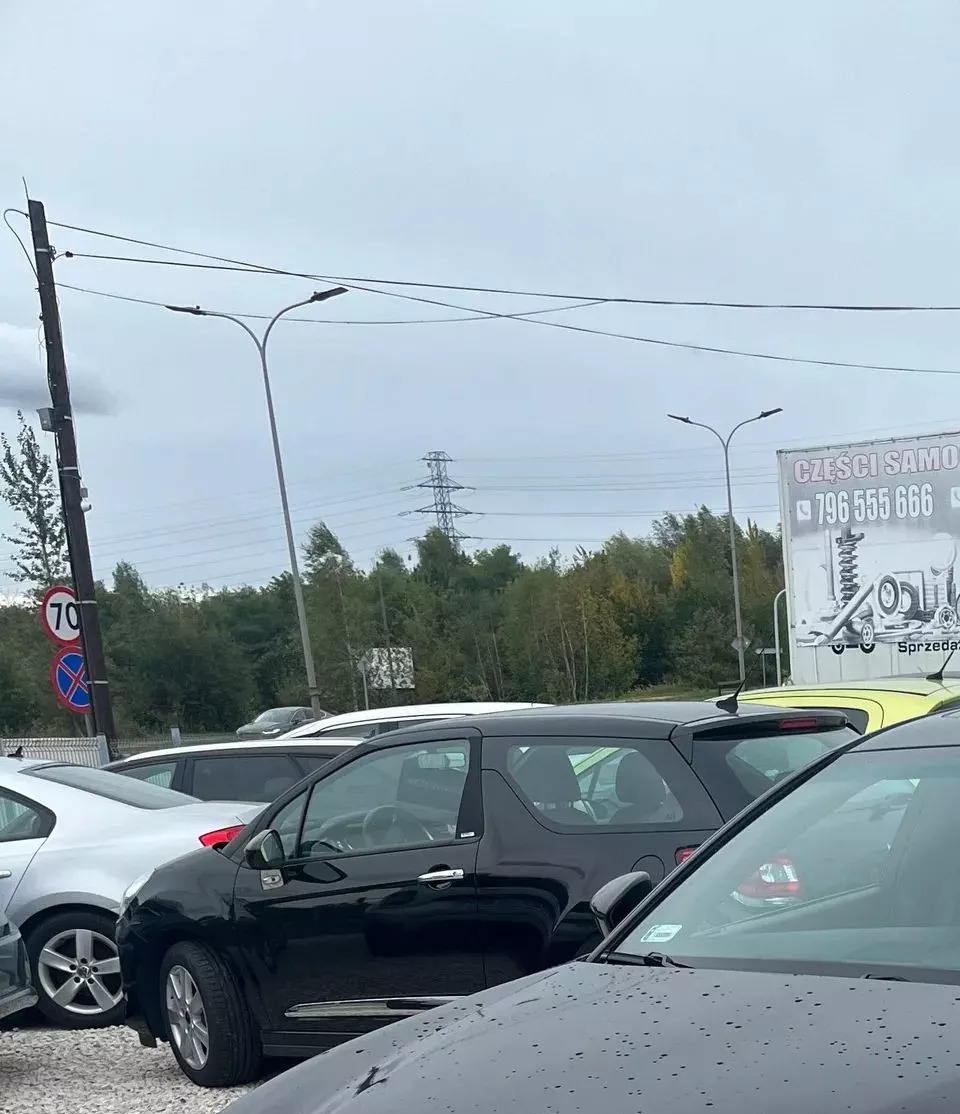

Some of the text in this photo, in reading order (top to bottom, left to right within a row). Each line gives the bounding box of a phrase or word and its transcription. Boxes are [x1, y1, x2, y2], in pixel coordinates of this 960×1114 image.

[794, 451, 878, 484] CZĘŚCI
[815, 482, 934, 525] 796 555 666
[50, 602, 80, 630] 70
